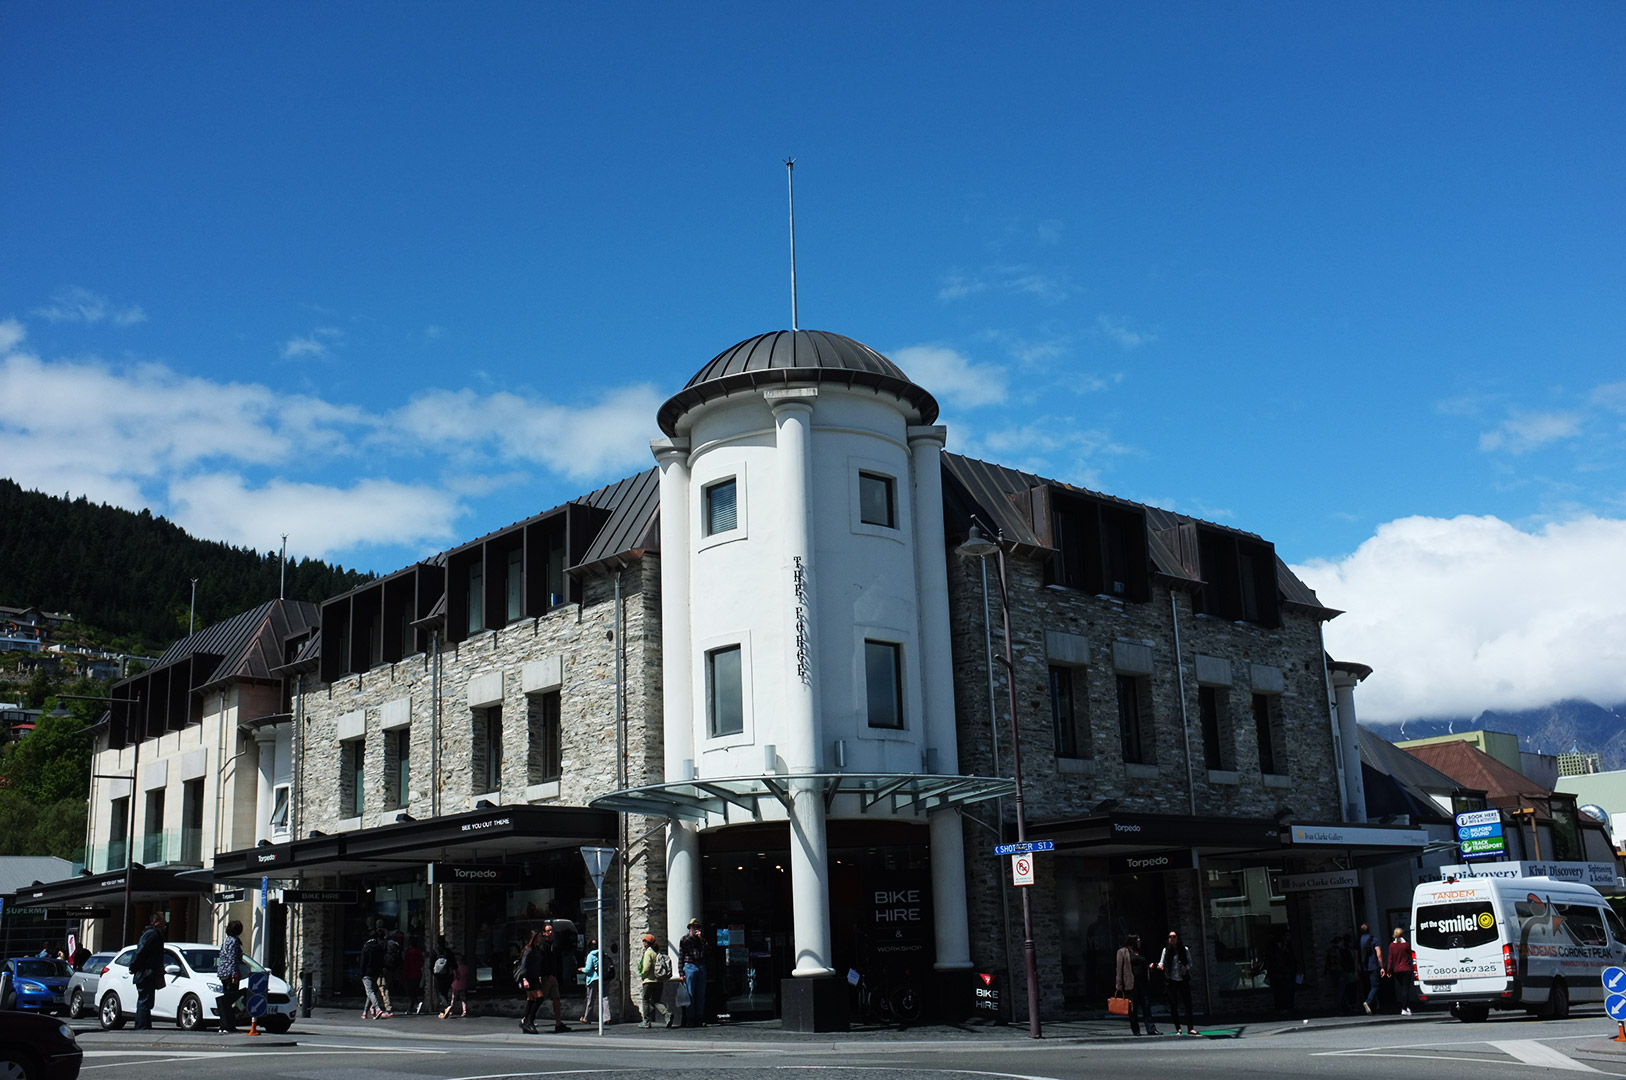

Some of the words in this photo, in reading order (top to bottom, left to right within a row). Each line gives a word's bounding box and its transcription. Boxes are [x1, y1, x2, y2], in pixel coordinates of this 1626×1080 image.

[793, 556, 802, 597] THE
[795, 606, 804, 677] FORGE
[472, 822, 482, 830] YOU
[482, 820, 493, 828] OUT
[494, 818, 510, 826] THERE
[1314, 832, 1328, 841] Clarke
[1328, 833, 1344, 842] Gallery
[1037, 841, 1047, 850] ST
[1473, 843, 1502, 851] TRANSPORT
[1419, 871, 1447, 882] Kiwi
[1453, 868, 1518, 881] Discovery
[1528, 865, 1547, 877] Kiwi
[1549, 865, 1584, 878] Discovery
[1292, 880, 1306, 888] Ivan
[1307, 878, 1329, 887] Clarke
[1330, 876, 1355, 886] Gallery
[302, 892, 320, 901] BIKE
[322, 892, 340, 901] HIRE
[874, 889, 921, 904] BIKE
[1432, 890, 1475, 900] TANDEM
[875, 907, 921, 922] HIRE
[1429, 920, 1438, 928] the
[1438, 914, 1479, 933] smile!
[895, 929, 904, 938] &
[876, 944, 923, 953] WORKSHOP
[1516, 945, 1557, 957] TANDEMS
[1558, 945, 1591, 957] CORONET
[1592, 948, 1613, 959] PEAK
[1433, 967, 1458, 975] 0800
[1478, 965, 1496, 973] 325
[976, 988, 999, 999] BIKE
[976, 1000, 999, 1011] HIRE
